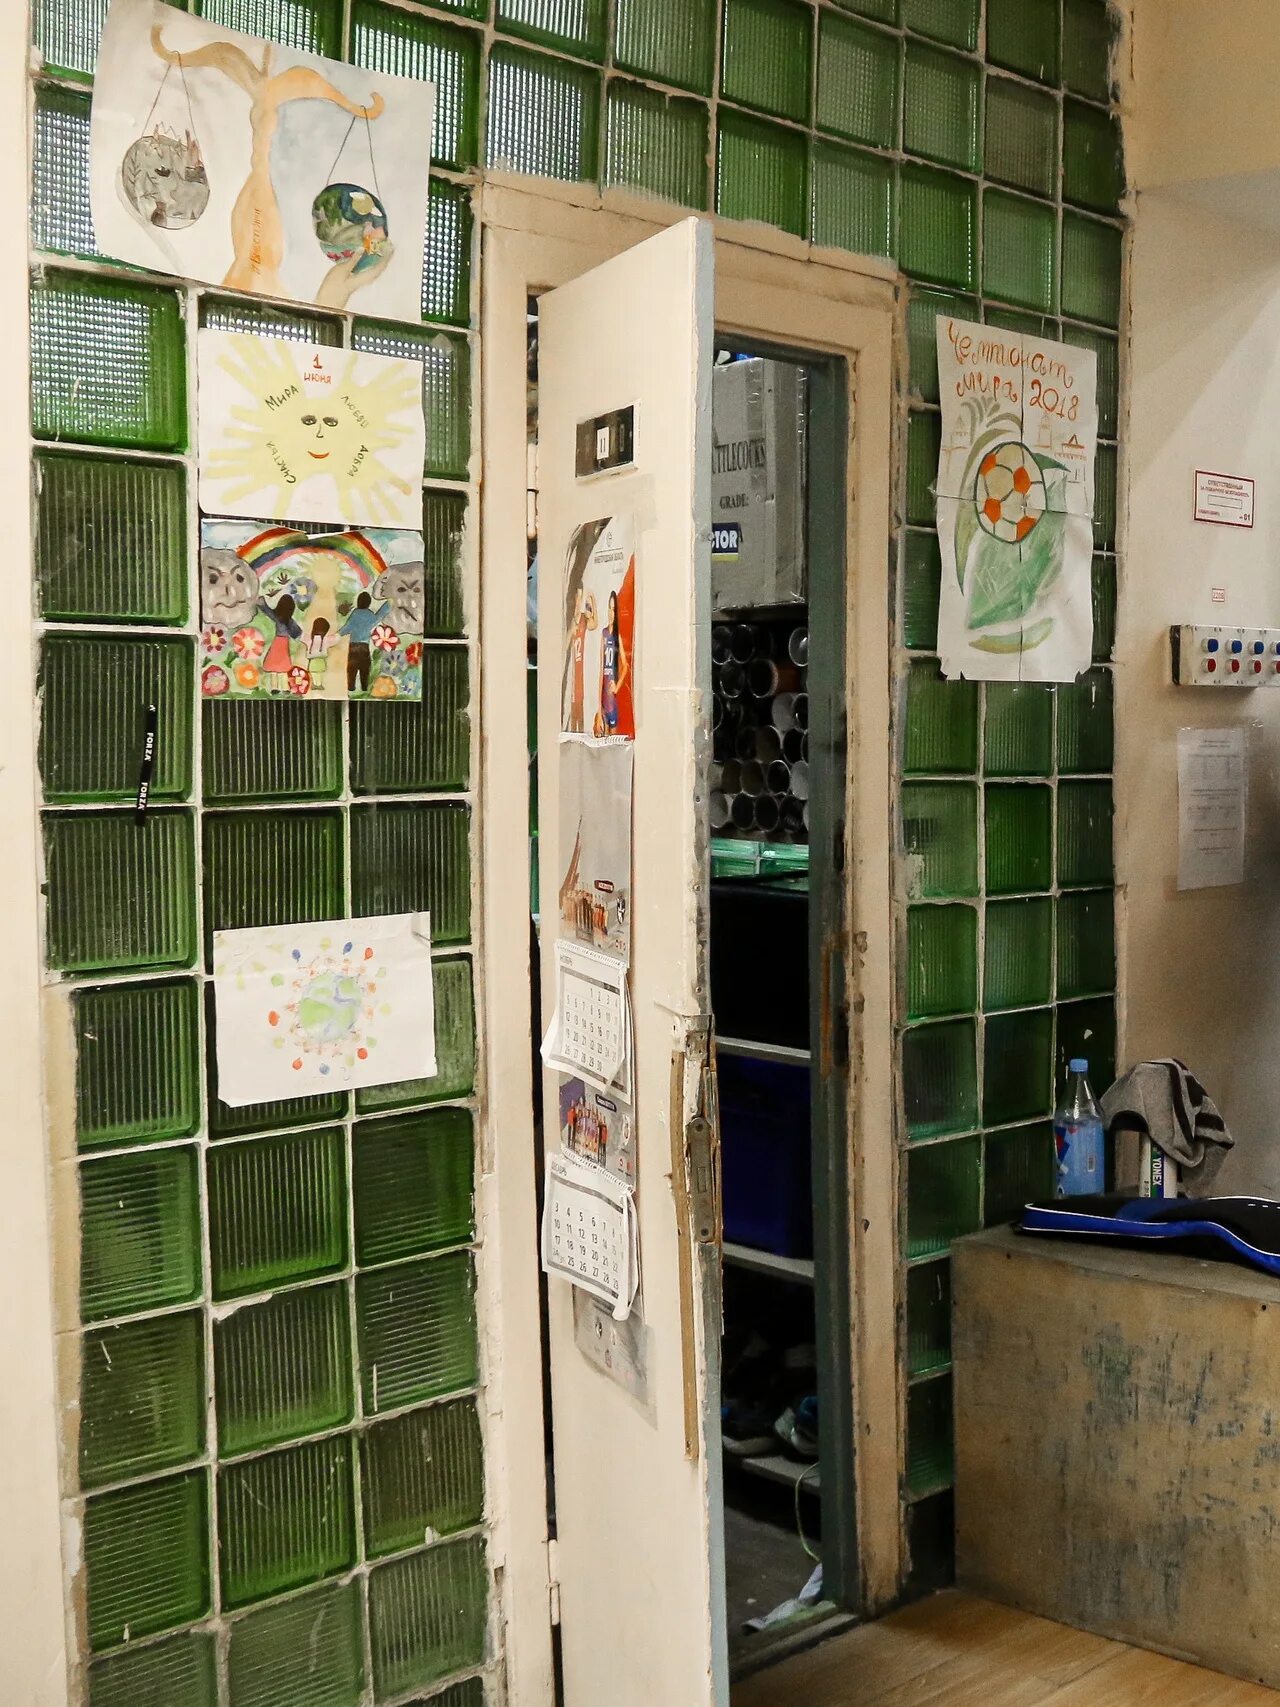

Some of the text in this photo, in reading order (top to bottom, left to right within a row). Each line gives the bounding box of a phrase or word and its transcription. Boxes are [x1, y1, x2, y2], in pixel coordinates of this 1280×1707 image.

[313, 354, 323, 369] 1
[1029, 378, 1079, 421] 2018
[144, 732, 154, 762] FORZA
[138, 782, 148, 811] FORZA
[1152, 1158, 1162, 1186] YONEX
[567, 1224, 572, 1234] 11
[579, 1229, 585, 1239] 12
[592, 1233, 597, 1244] 13
[567, 1240, 573, 1250] 18
[579, 1245, 586, 1255] 19
[592, 1250, 598, 1261] 20
[568, 1256, 574, 1267] 25
[579, 1261, 587, 1272] 26
